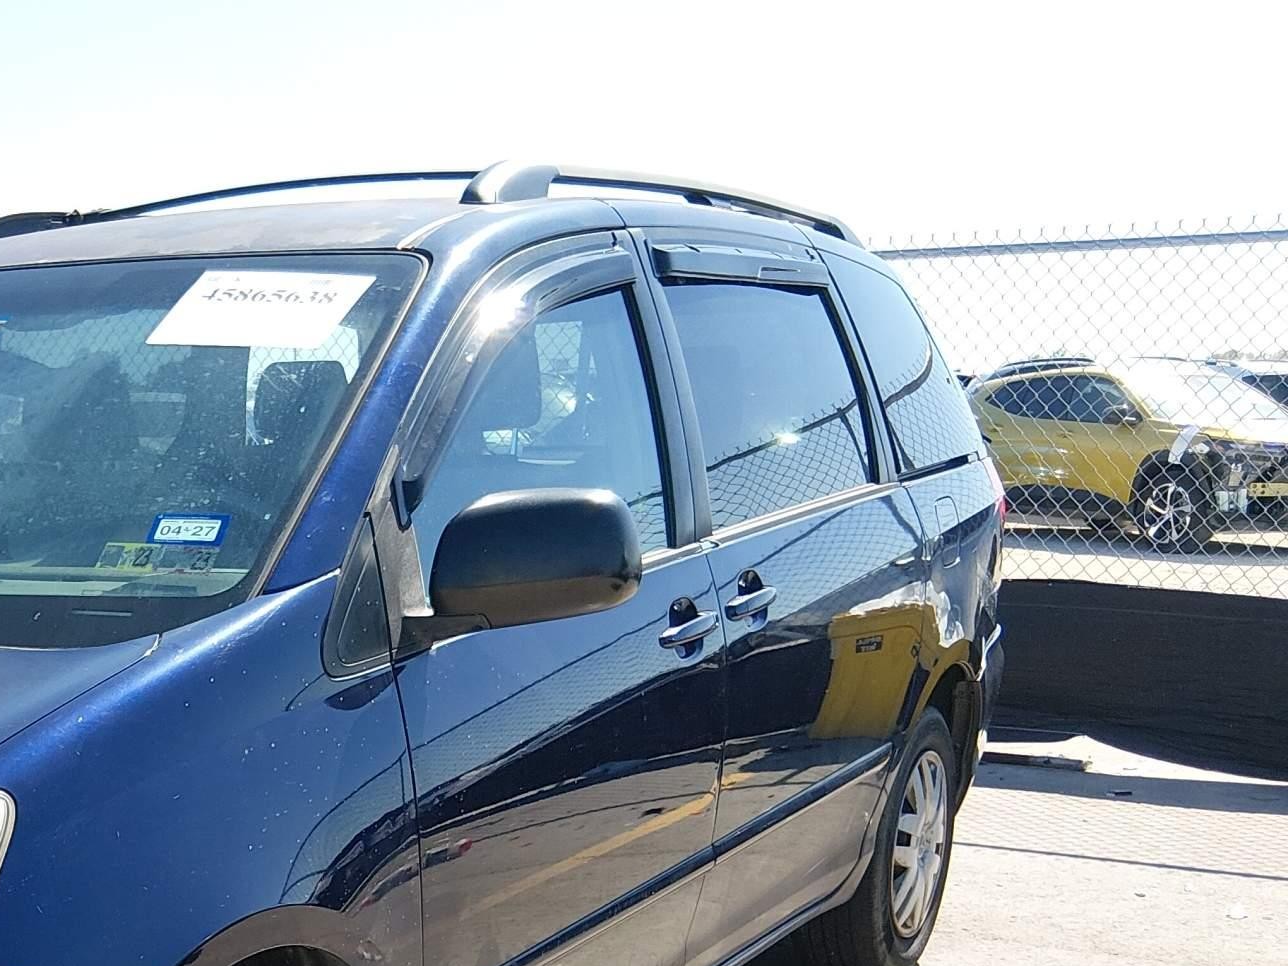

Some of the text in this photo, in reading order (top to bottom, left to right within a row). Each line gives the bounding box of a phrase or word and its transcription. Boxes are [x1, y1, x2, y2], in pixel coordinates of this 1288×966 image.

[202, 287, 339, 305] 45865638
[159, 525, 217, 537] 04 27
